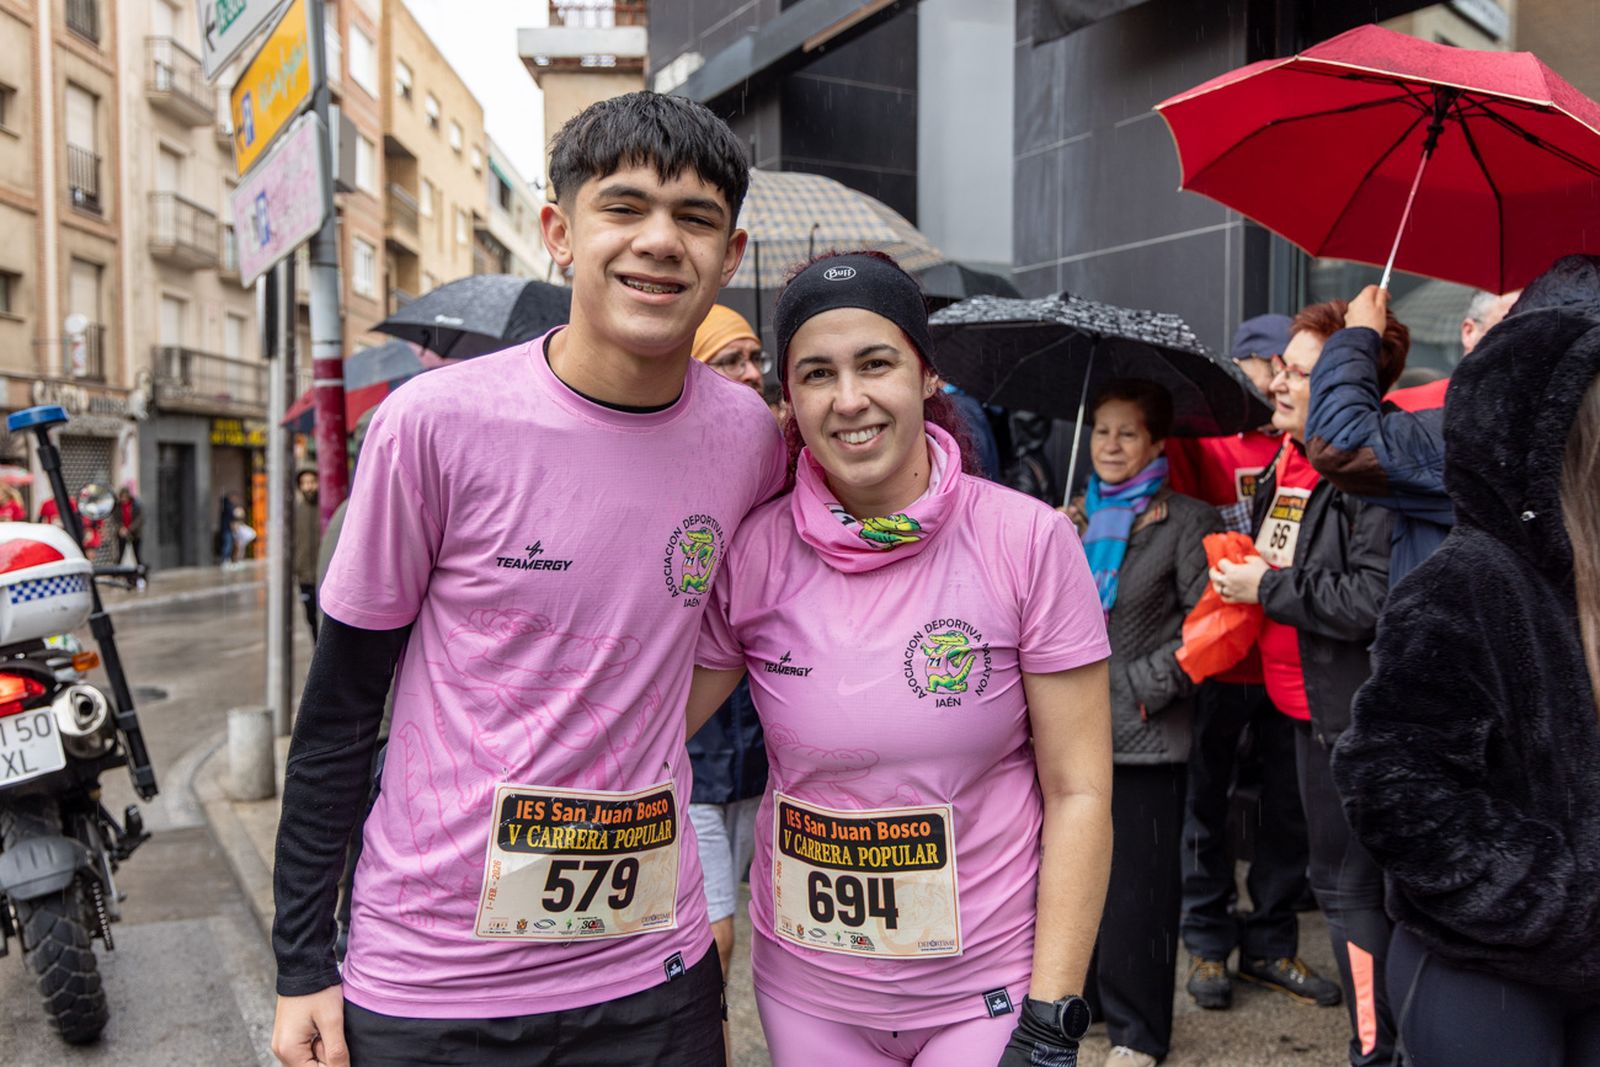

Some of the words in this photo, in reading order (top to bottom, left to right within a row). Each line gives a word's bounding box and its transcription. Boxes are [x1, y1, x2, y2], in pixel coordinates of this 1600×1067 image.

[829, 269, 851, 279] Buff
[496, 557, 573, 571] TEAMERGY
[664, 527, 682, 598] ASOCIACION
[683, 514, 723, 538] DEPORTIVA
[764, 662, 813, 677] TEAMERGY
[904, 631, 928, 699] ASOCIACION
[924, 618, 982, 642] DEPORTIVA
[975, 643, 993, 697] MARATON
[1, 749, 38, 778] XL
[516, 800, 545, 821] IES
[551, 802, 586, 823] San
[591, 805, 632, 824] Juan
[636, 798, 669, 820] Bosco
[785, 808, 802, 829] IES
[804, 815, 827, 838] San
[831, 822, 871, 841] Juan
[877, 821, 931, 840] Bosco
[508, 823, 522, 846] V
[526, 824, 608, 850] CARRERA
[614, 819, 672, 849] POPULAR
[783, 829, 792, 849] V
[794, 834, 854, 866] CARRERA
[857, 843, 940, 867] POPULAR
[541, 857, 640, 913] 579
[808, 870, 899, 930] 694
